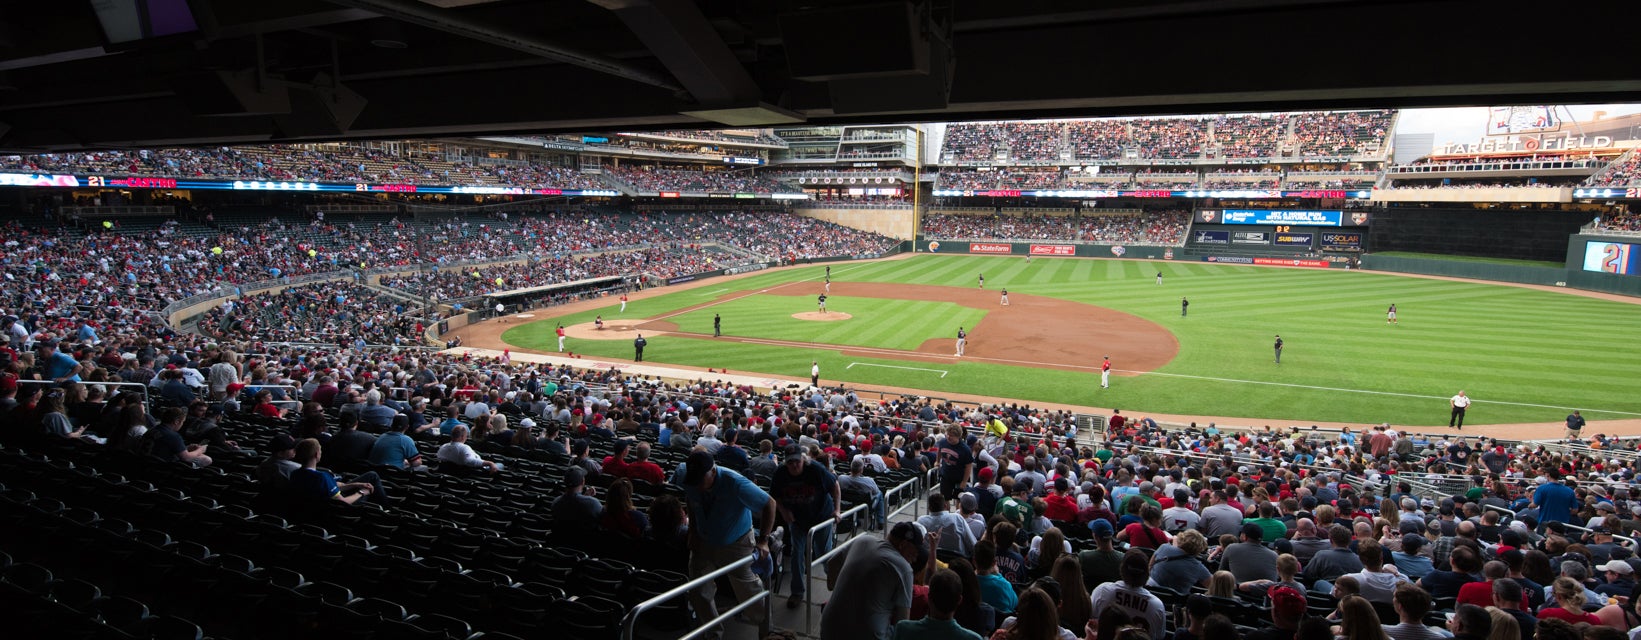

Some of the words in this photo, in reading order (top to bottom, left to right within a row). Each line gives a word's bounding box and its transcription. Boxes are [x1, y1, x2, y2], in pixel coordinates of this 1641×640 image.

[1445, 140, 1521, 154] TARGET
[1543, 136, 1611, 150] FIELD
[88, 176, 105, 187] 21
[127, 177, 176, 188] CASTRO
[356, 183, 368, 192] 21
[384, 184, 417, 193] CASTRO
[1301, 190, 1346, 198] CASTRO
[1277, 235, 1310, 243] SUBWAY
[1601, 243, 1631, 275] 21
[1175, 519, 1187, 529] 7
